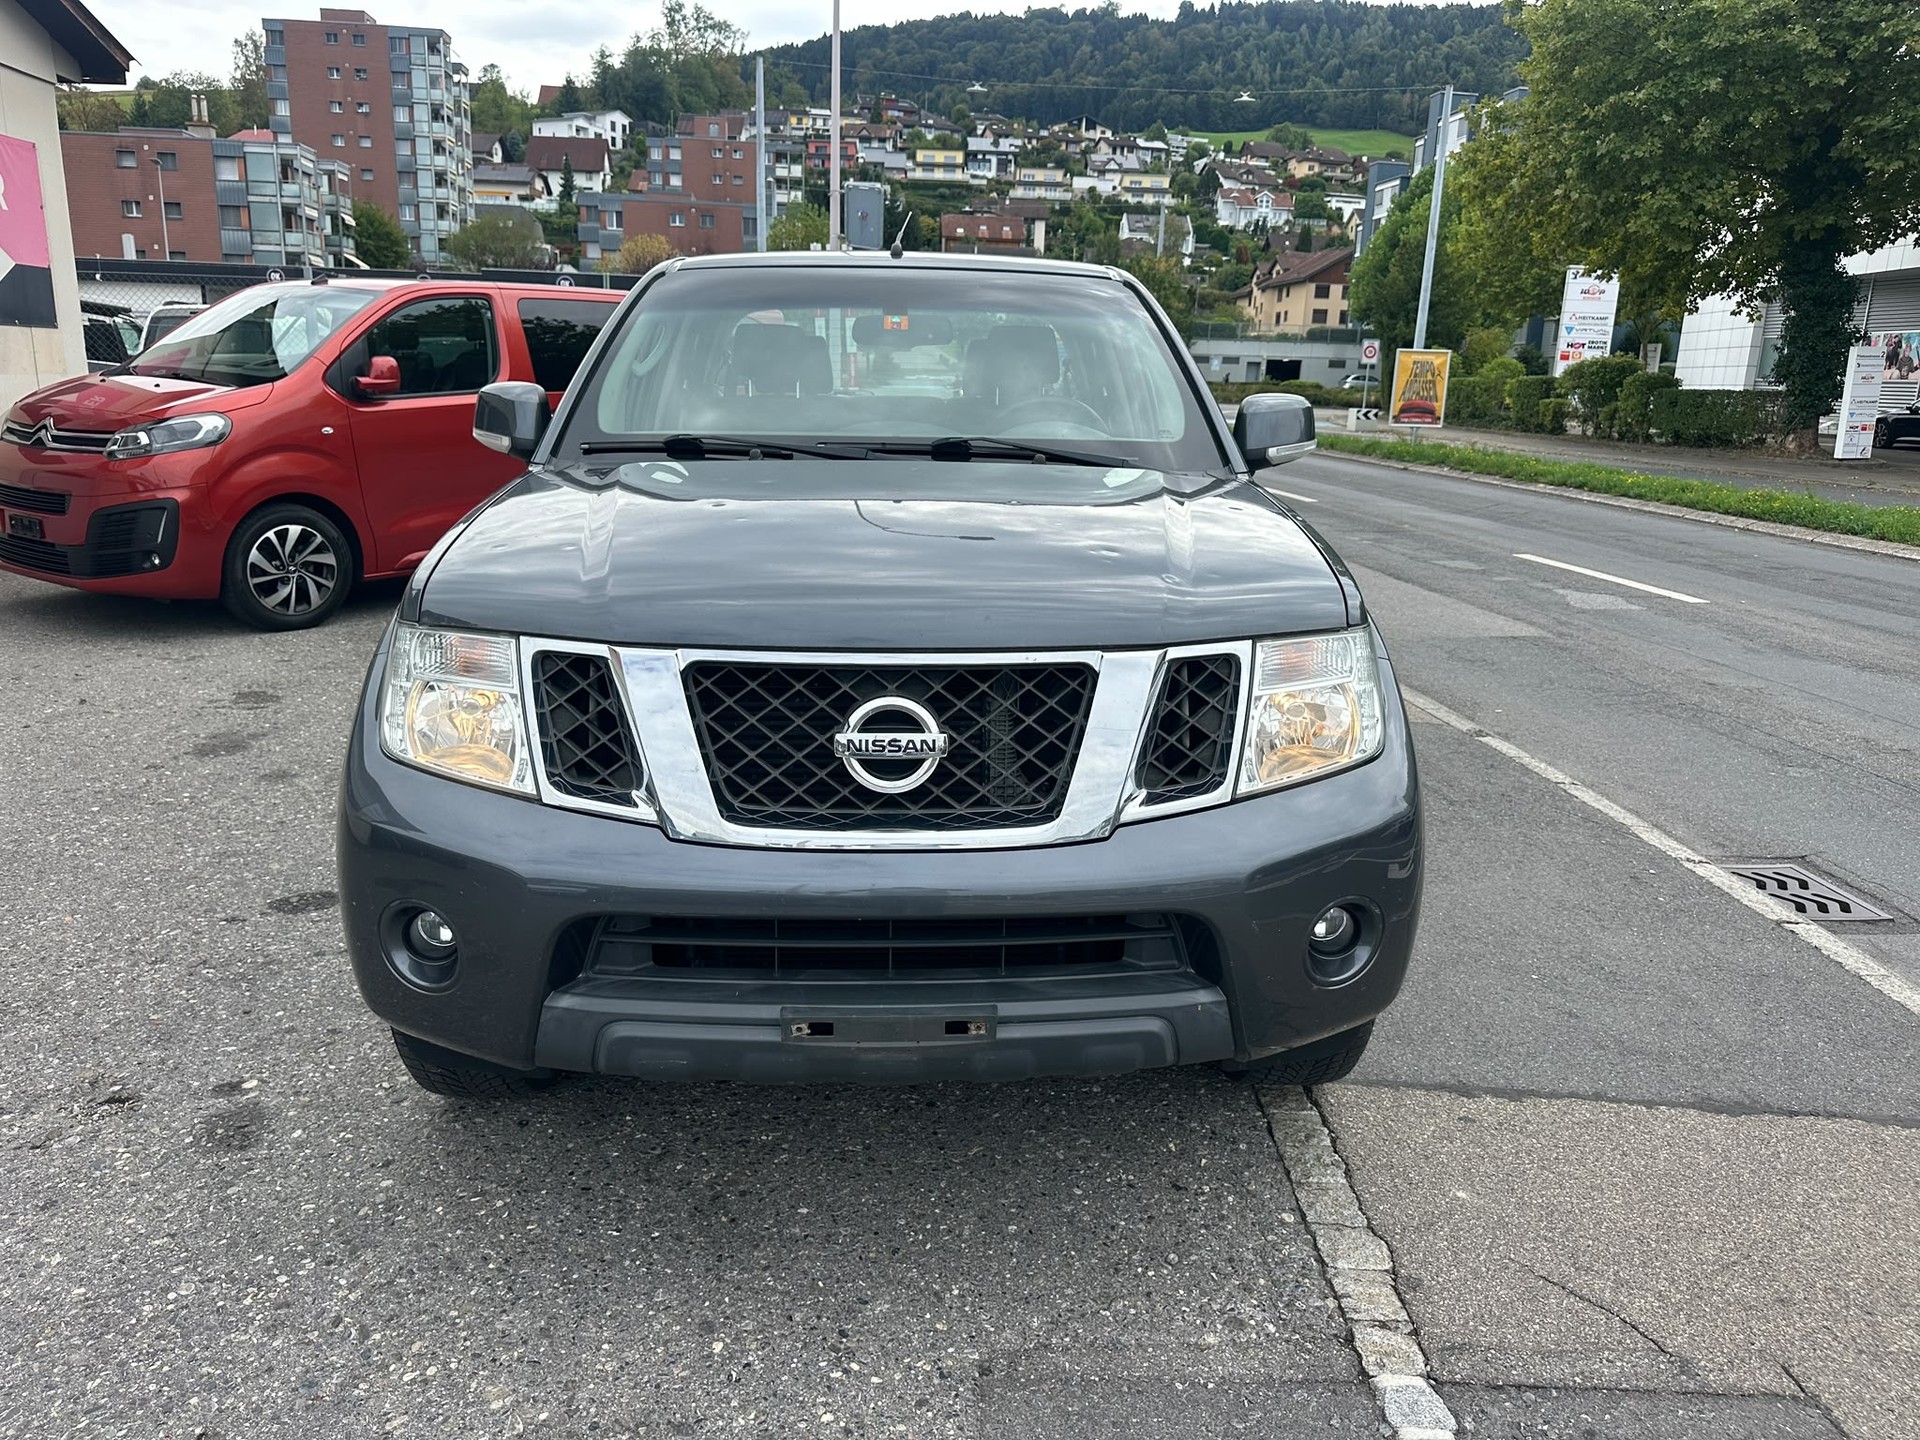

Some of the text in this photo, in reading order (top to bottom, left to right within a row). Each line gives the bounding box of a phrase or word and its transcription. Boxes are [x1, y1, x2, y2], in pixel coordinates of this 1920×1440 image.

[270, 271, 281, 281] OK
[1408, 360, 1436, 379] TEMPO
[846, 738, 936, 753] NISSAN
